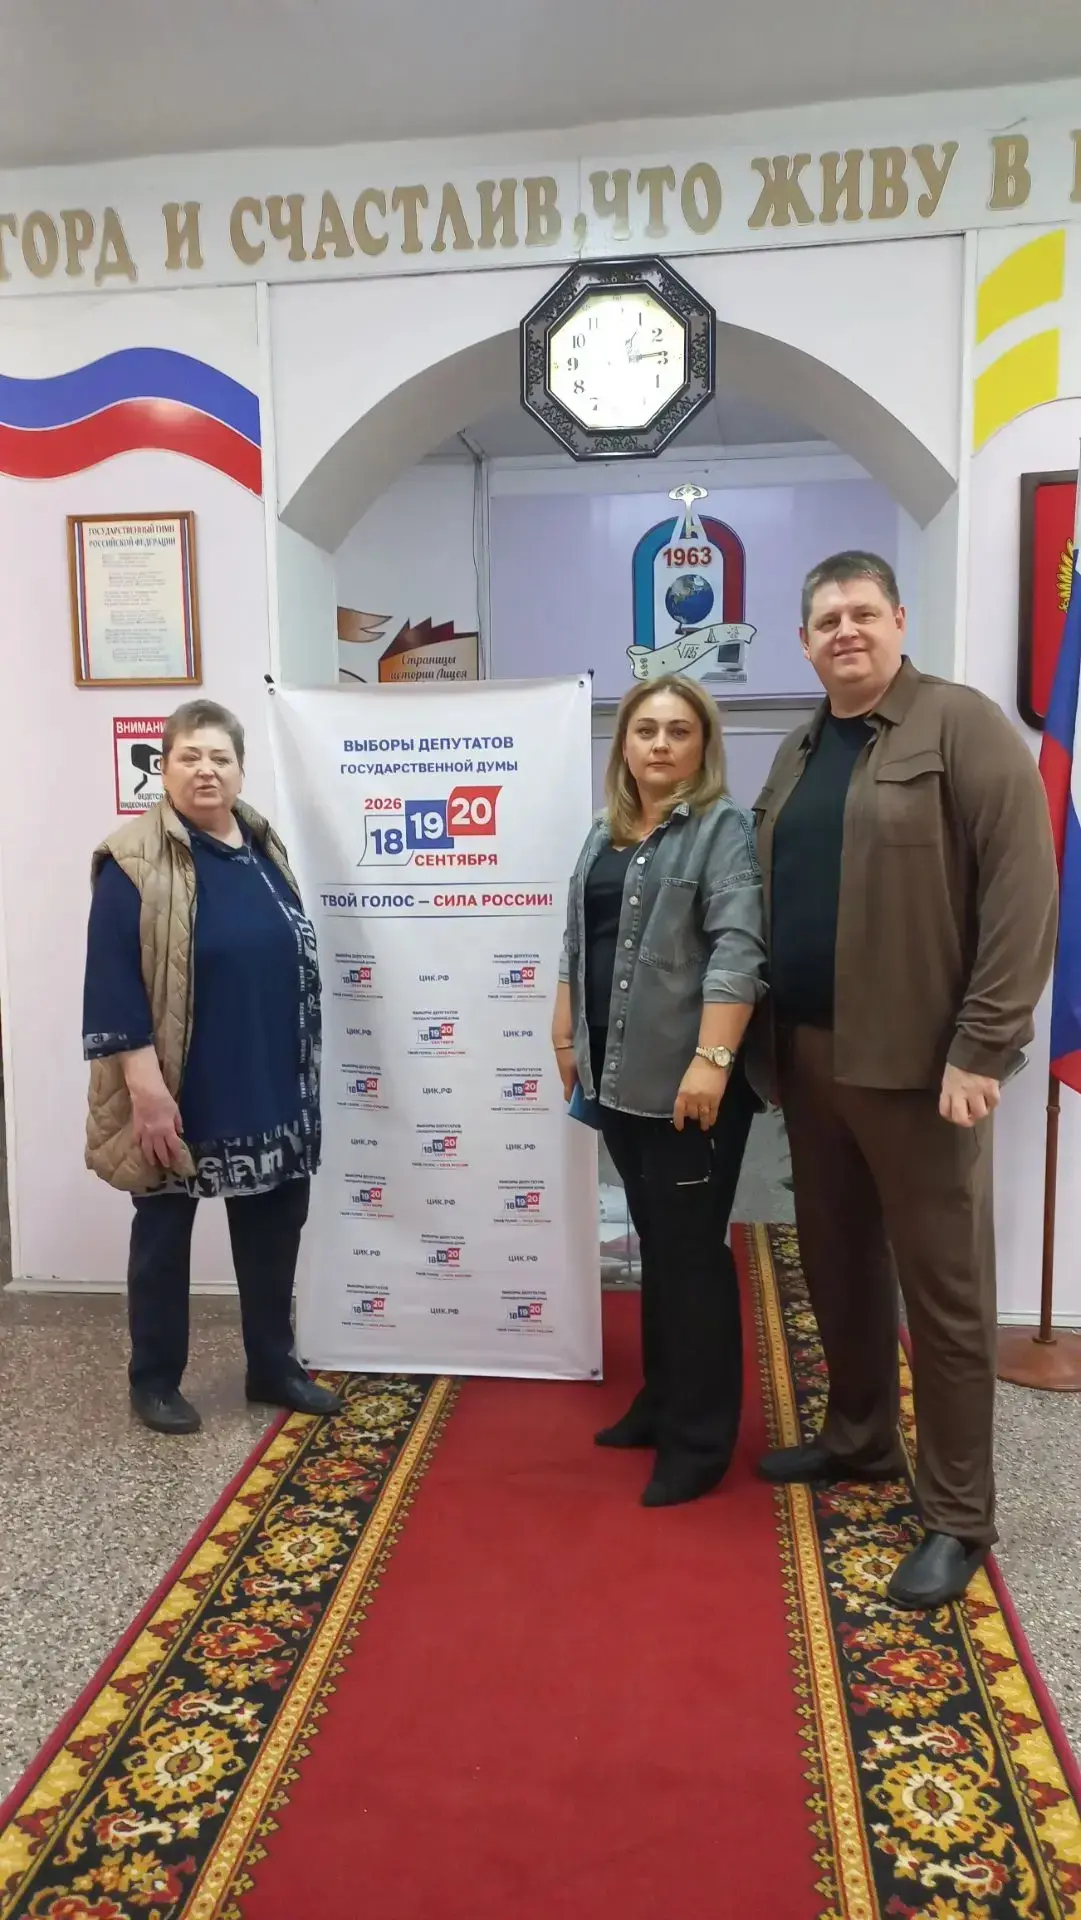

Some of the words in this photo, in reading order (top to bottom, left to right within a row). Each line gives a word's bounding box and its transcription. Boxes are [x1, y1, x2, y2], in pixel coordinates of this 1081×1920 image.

[162, 201, 204, 270] И
[747, 141, 960, 230] ЖИВУ
[985, 133, 1032, 211] В
[572, 333, 586, 349] 10
[651, 327, 664, 343] 2
[567, 357, 579, 371] 9
[573, 379, 586, 395] 8
[663, 546, 712, 567] 1963
[401, 654, 456, 667] Страницы
[391, 670, 434, 681] истории
[436, 668, 467, 681] Лицея
[344, 739, 414, 752] ВЫБОРЫ
[418, 736, 514, 752] ДЕПУТАТОВ
[340, 760, 473, 775] ГОСУДАРСТВЕННОЙ
[476, 761, 518, 774] ДУМЫ
[365, 798, 402, 810] 2026
[451, 797, 492, 825] 20
[410, 812, 444, 840] 19
[370, 828, 404, 855] 18
[415, 854, 498, 866] СЕНТЯБРЯ
[320, 893, 357, 907] ТВОЙ
[361, 895, 414, 907] ГОЛОС
[433, 895, 477, 907] СИЛА
[482, 894, 553, 906] РОССИИ!
[419, 974, 450, 983] ЦИК.РФ
[522, 969, 534, 978] 20
[441, 1025, 452, 1033] 20
[503, 1030, 533, 1038] ЦИК.РФ
[422, 1087, 453, 1095] ЦИК.РФ
[525, 1082, 536, 1091] 20
[444, 1139, 455, 1147] 20
[505, 1143, 536, 1151] ЦИК.РФ
[370, 1189, 380, 1198] 20
[527, 1195, 538, 1203] 20
[426, 1198, 456, 1206] ЦИК.РФ
[447, 1250, 458, 1258] 20
[373, 1300, 383, 1308] 20
[530, 1305, 541, 1313] 20
